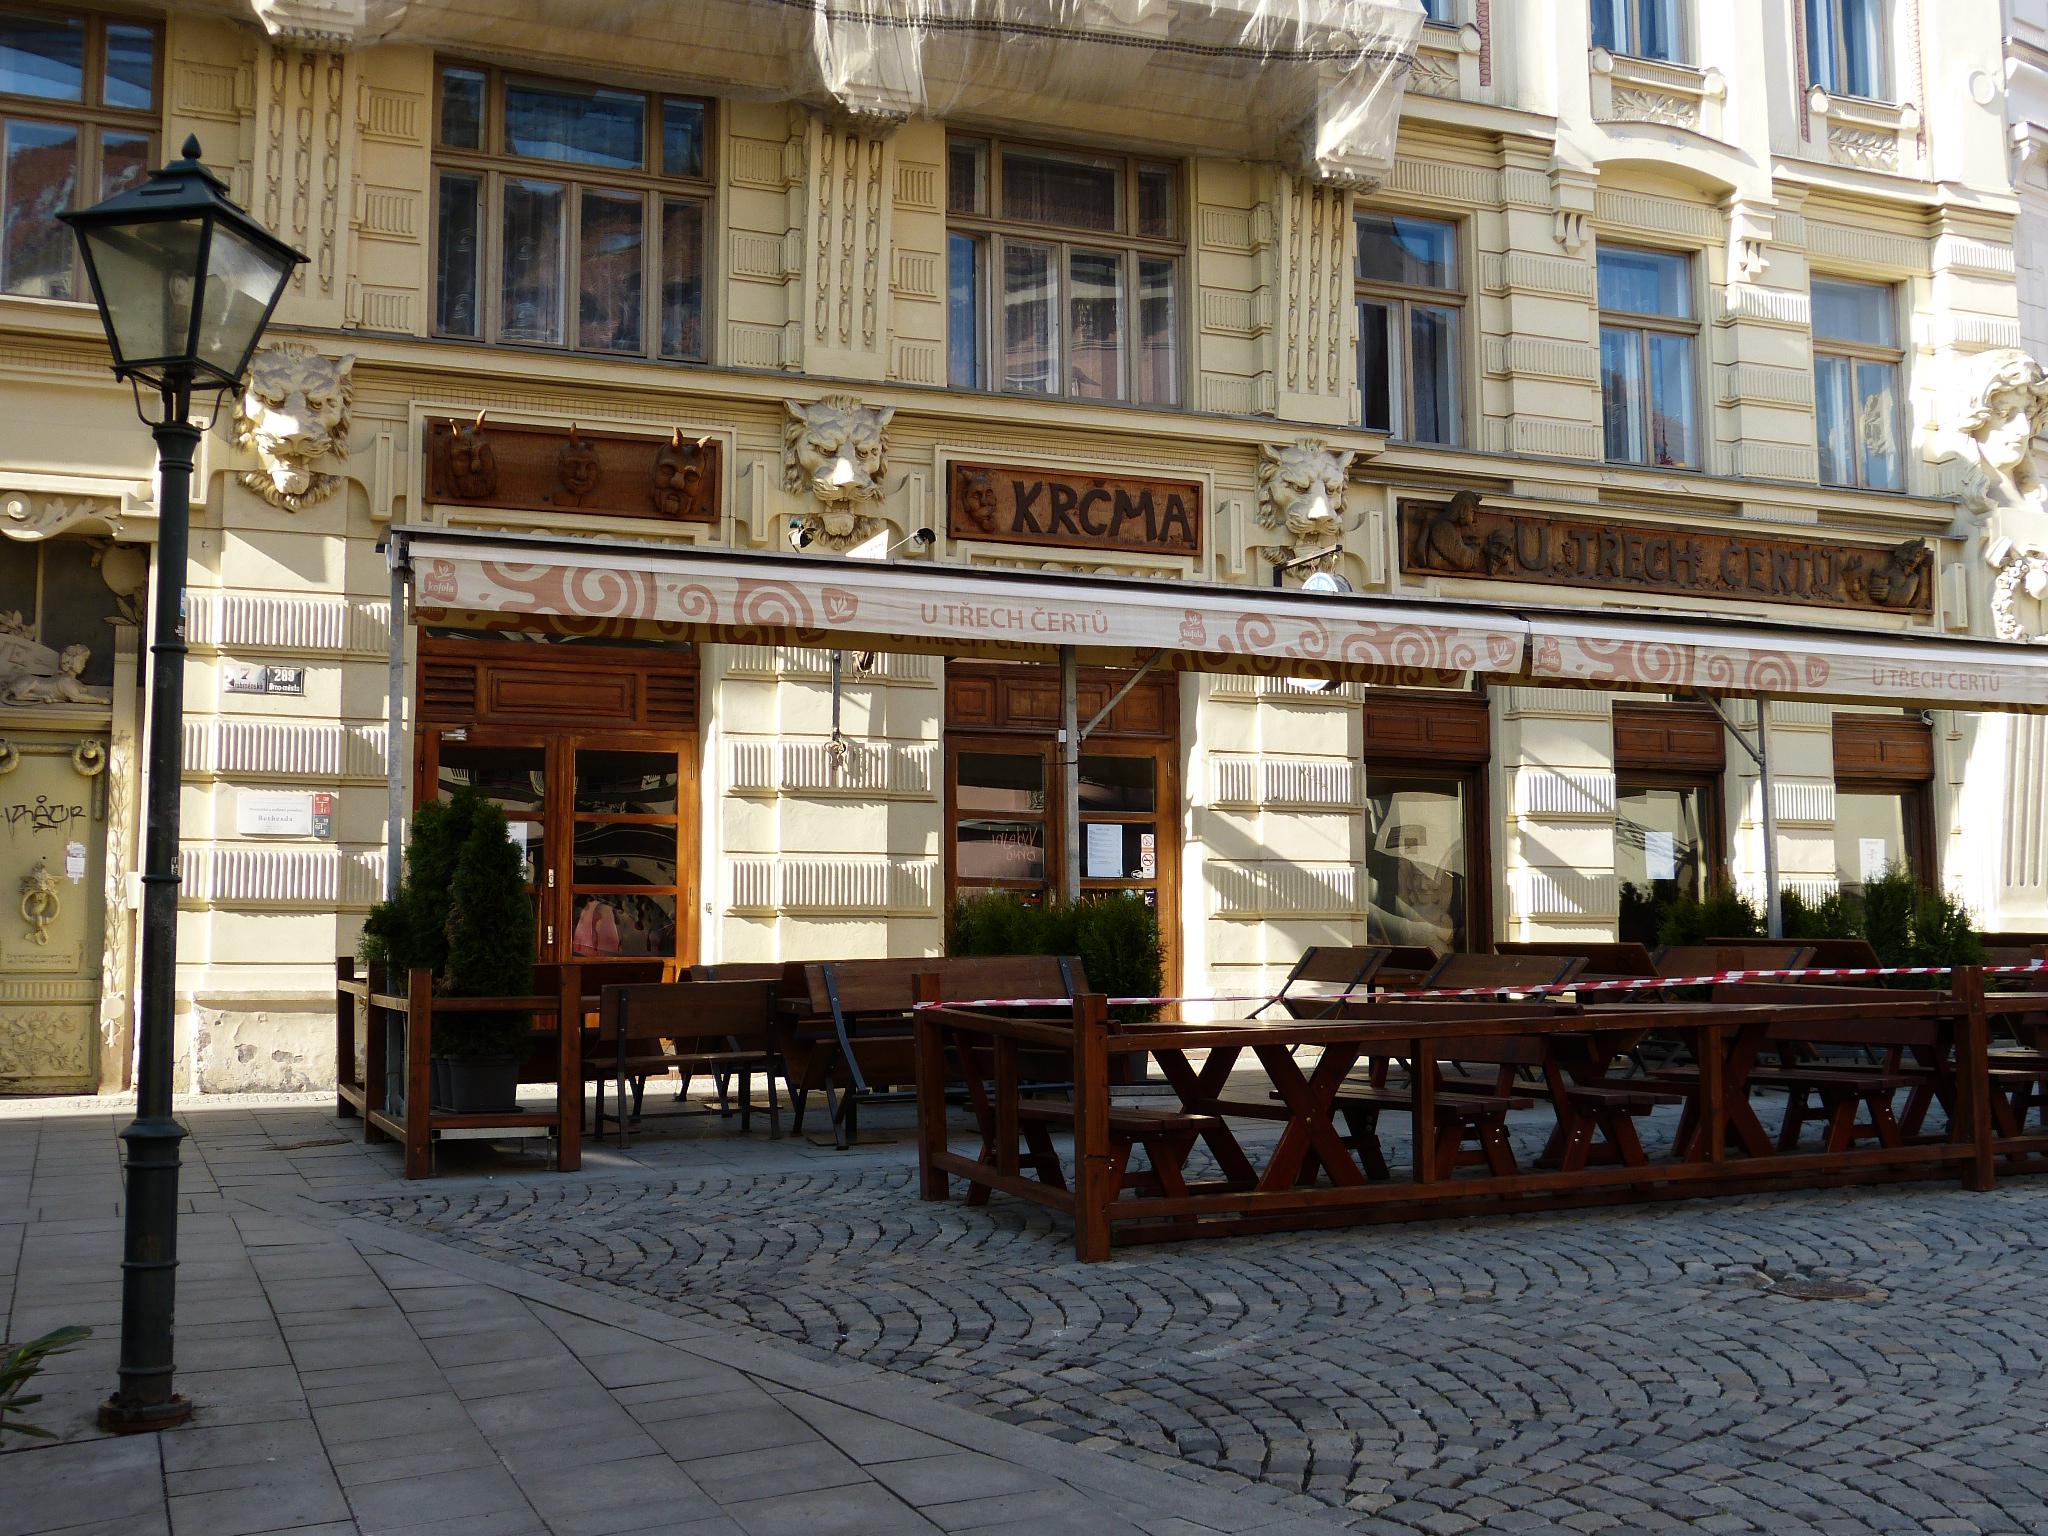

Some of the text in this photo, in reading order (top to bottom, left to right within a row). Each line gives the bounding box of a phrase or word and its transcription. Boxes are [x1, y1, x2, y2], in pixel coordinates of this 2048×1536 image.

[1011, 479, 1197, 543] KRČMA
[1514, 516, 1837, 596] U TŘECH ČERTŮ
[920, 602, 1109, 634] U TŘECH ČERTŮ
[1872, 667, 2000, 692] U TŘECH ČERTŮ
